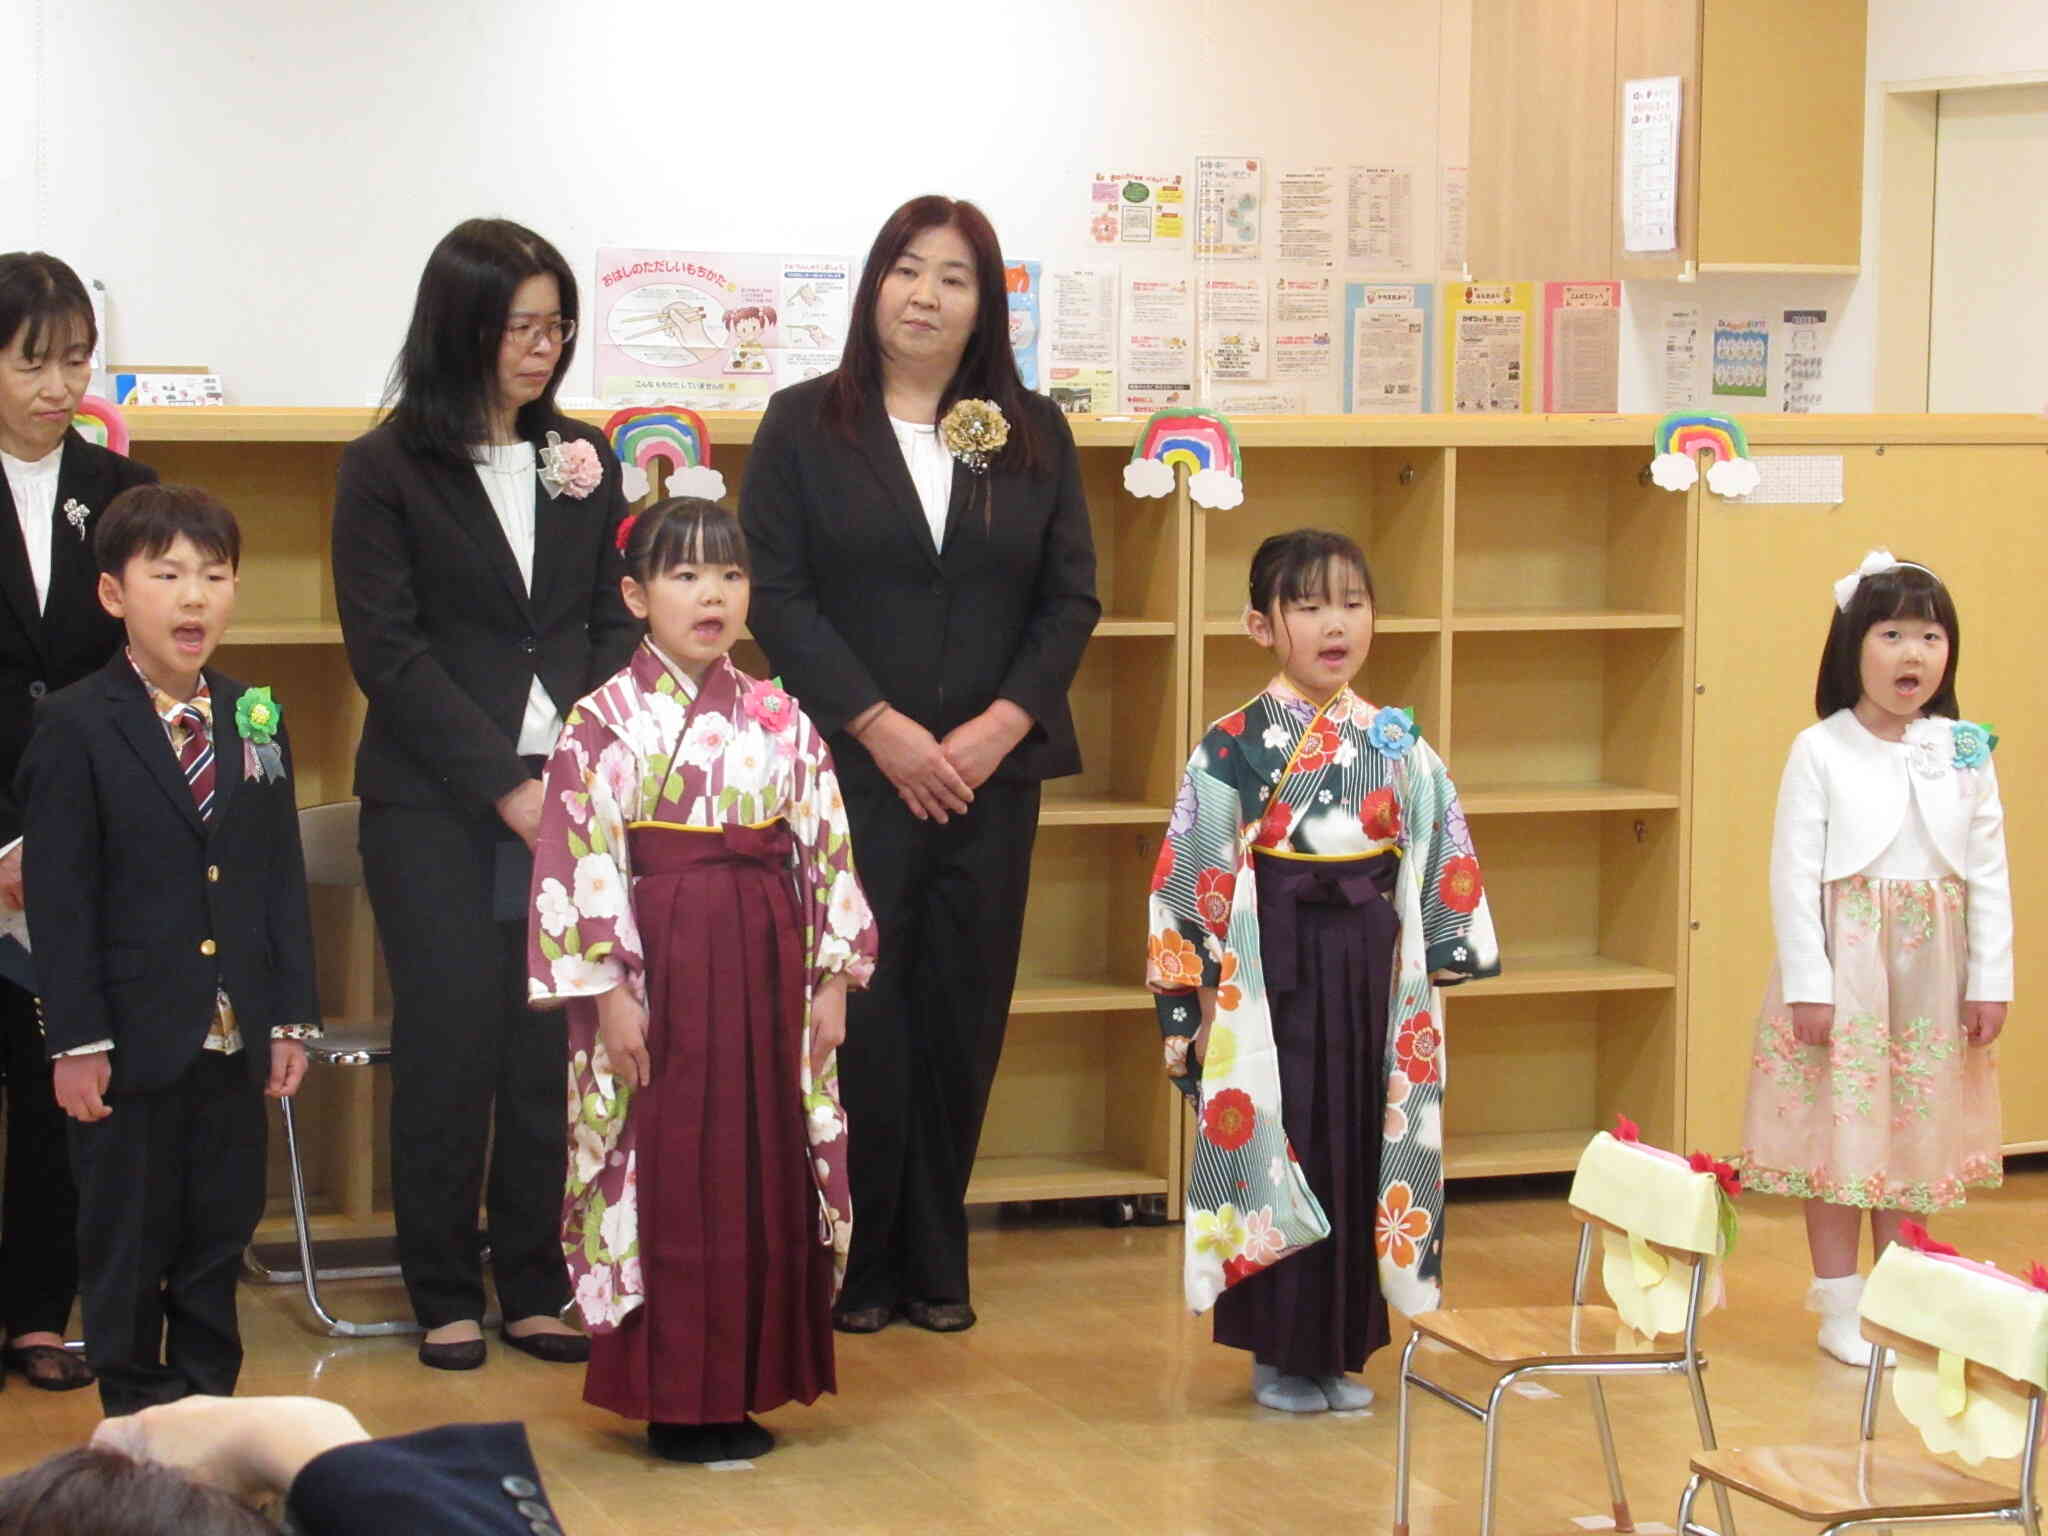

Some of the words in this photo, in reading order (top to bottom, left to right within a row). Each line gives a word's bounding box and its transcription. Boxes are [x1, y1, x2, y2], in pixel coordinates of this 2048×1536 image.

[601, 260, 727, 287] おはしのただしいもちかた
